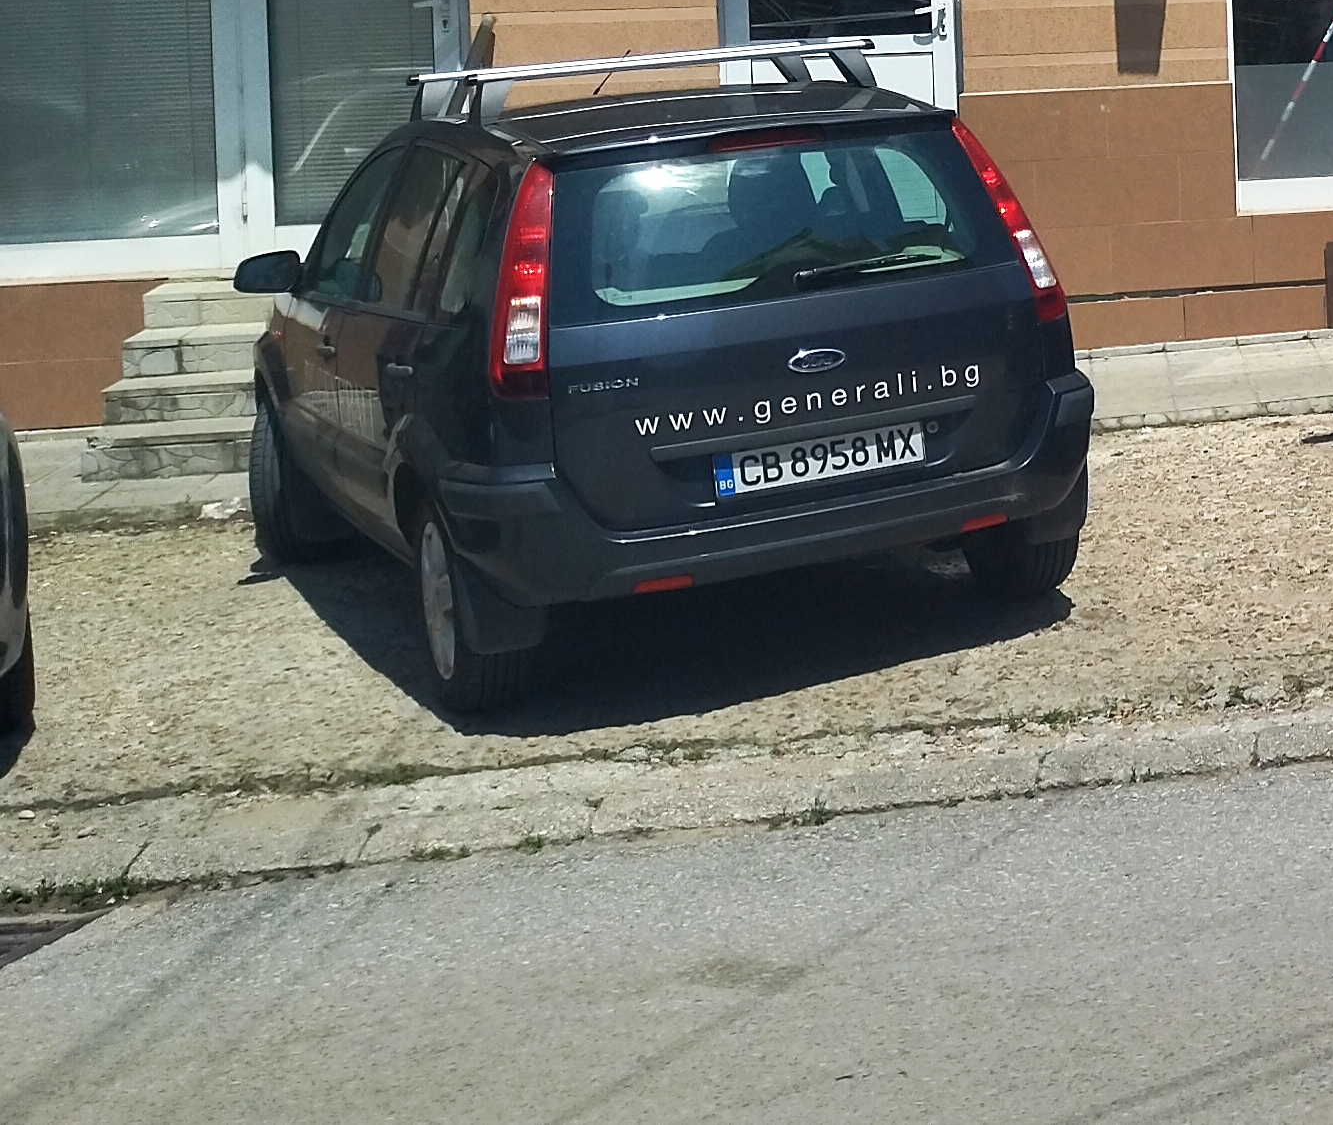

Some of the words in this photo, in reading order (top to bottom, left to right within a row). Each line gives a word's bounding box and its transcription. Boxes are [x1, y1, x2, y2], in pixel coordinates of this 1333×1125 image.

[567, 377, 640, 394] FUSION
[635, 363, 980, 436] www.generali.bg
[791, 437, 870, 474] 8958
[719, 478, 734, 490] BG
